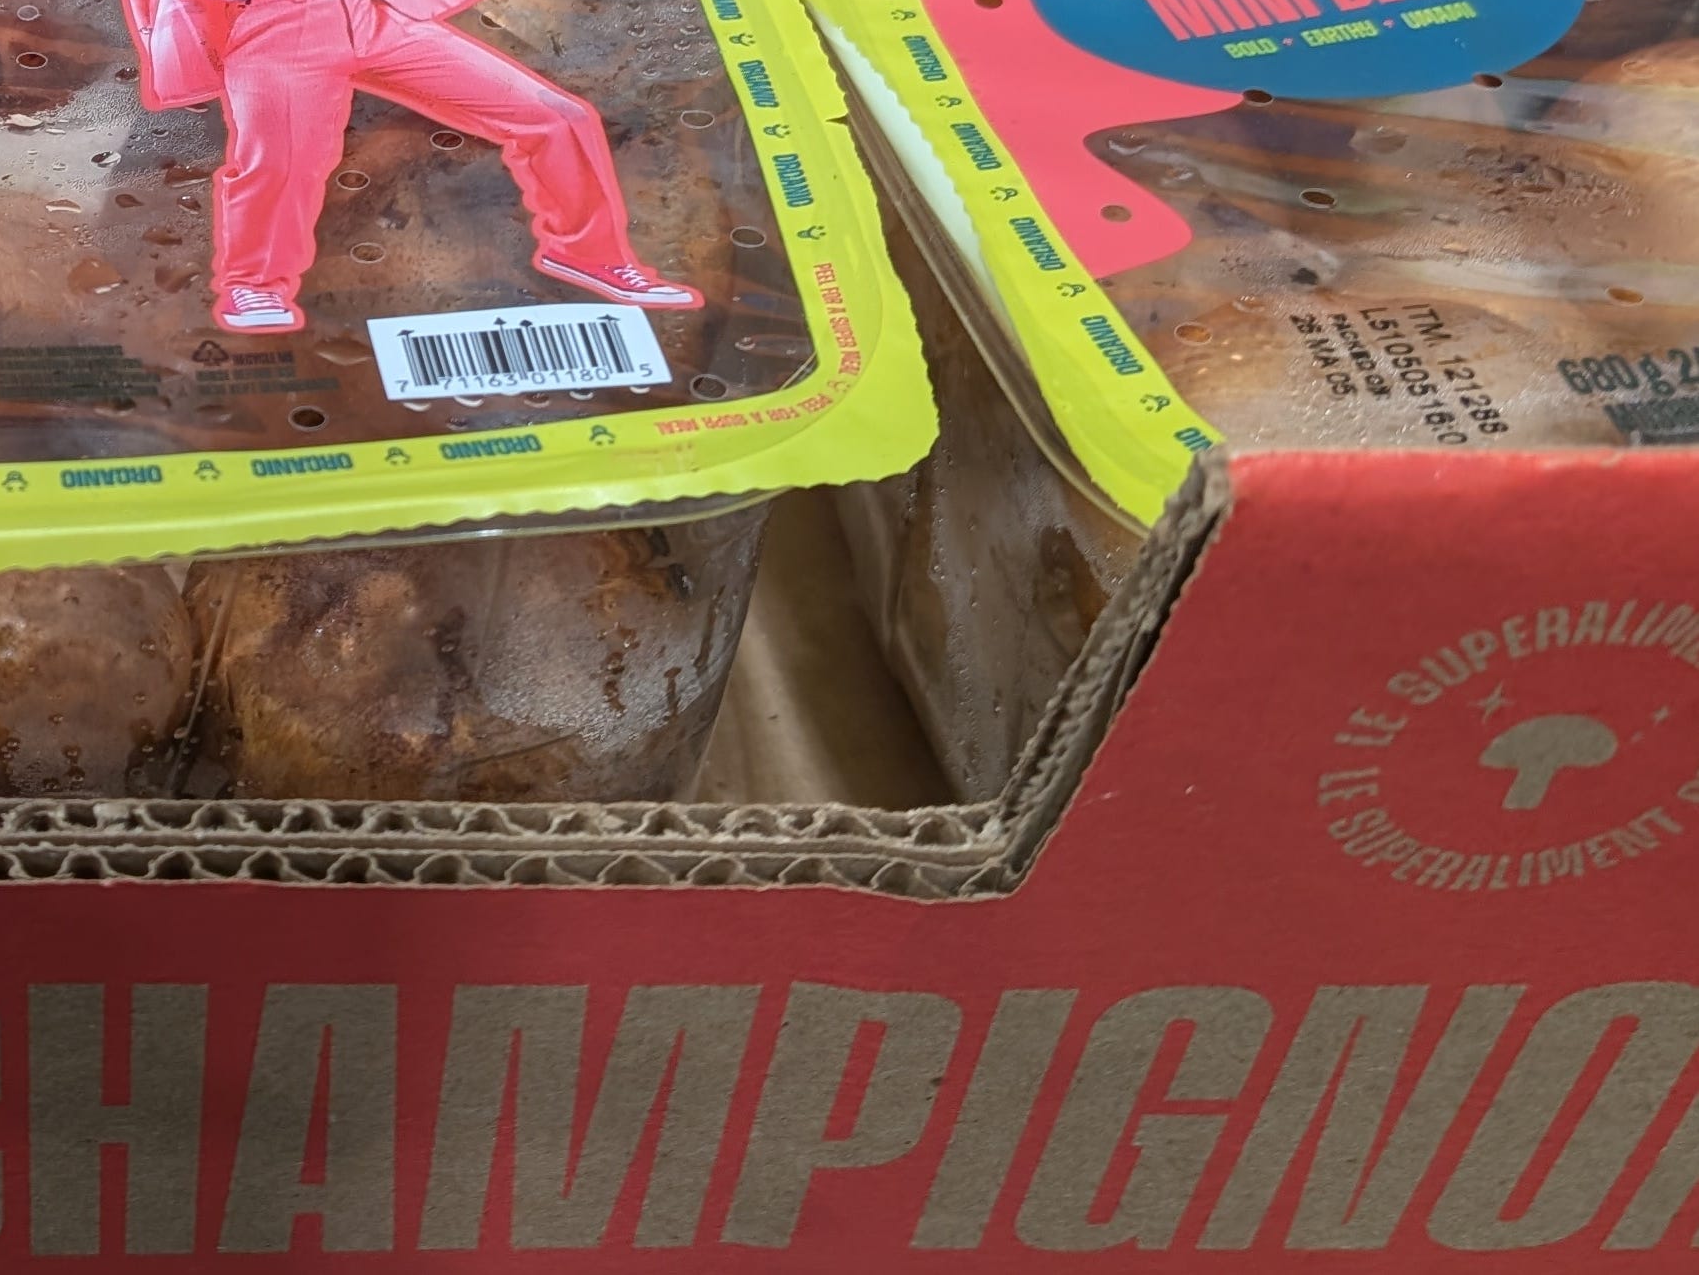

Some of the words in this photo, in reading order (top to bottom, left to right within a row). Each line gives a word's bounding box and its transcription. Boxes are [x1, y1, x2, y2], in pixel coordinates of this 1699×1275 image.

[1223, 38, 1279, 59] BOLD
[1301, 20, 1379, 47] EARTHY
[1401, 1, 1477, 29] UMAMI
[1306, 338, 1339, 368] MA
[1557, 353, 1639, 395] 680
[396, 380, 408, 393] 7
[443, 374, 518, 390] 71163
[531, 368, 610, 384] 01180
[639, 363, 653, 377] 5
[1359, 307, 1438, 397] L510505
[1419, 399, 1467, 444] 16:0
[1438, 355, 1509, 434] 121288
[251, 452, 353, 477] ORGANIC
[439, 434, 543, 460] ORGANIC
[60, 465, 162, 488] ORGANIC
[1333, 706, 1409, 748] LE
[1327, 804, 1684, 892] SUPERALIMENT
